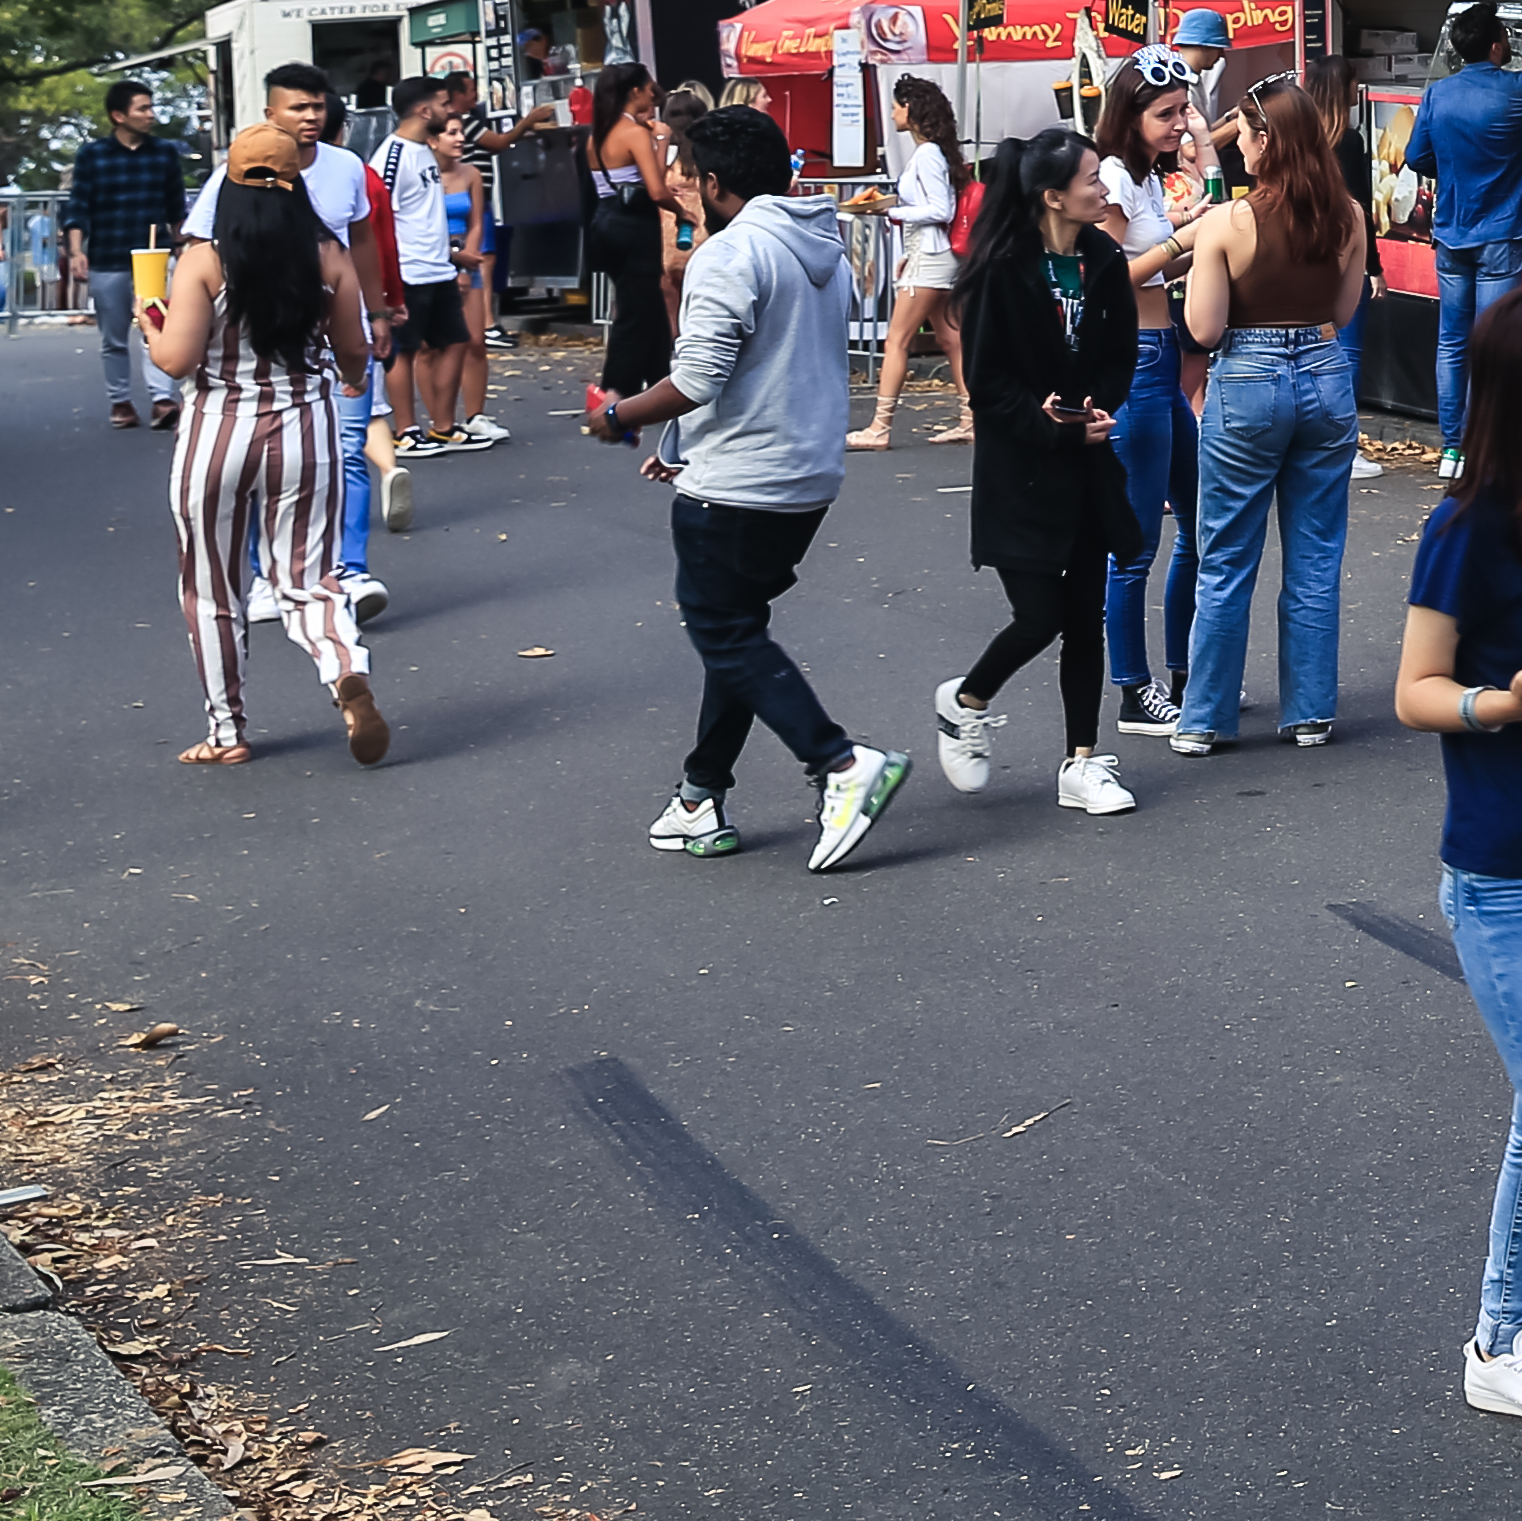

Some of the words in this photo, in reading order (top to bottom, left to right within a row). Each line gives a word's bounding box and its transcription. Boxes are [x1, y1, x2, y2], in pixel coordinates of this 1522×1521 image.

[280, 6, 304, 19] WE
[308, 5, 357, 17] CATER
[360, 3, 391, 14] FOR
